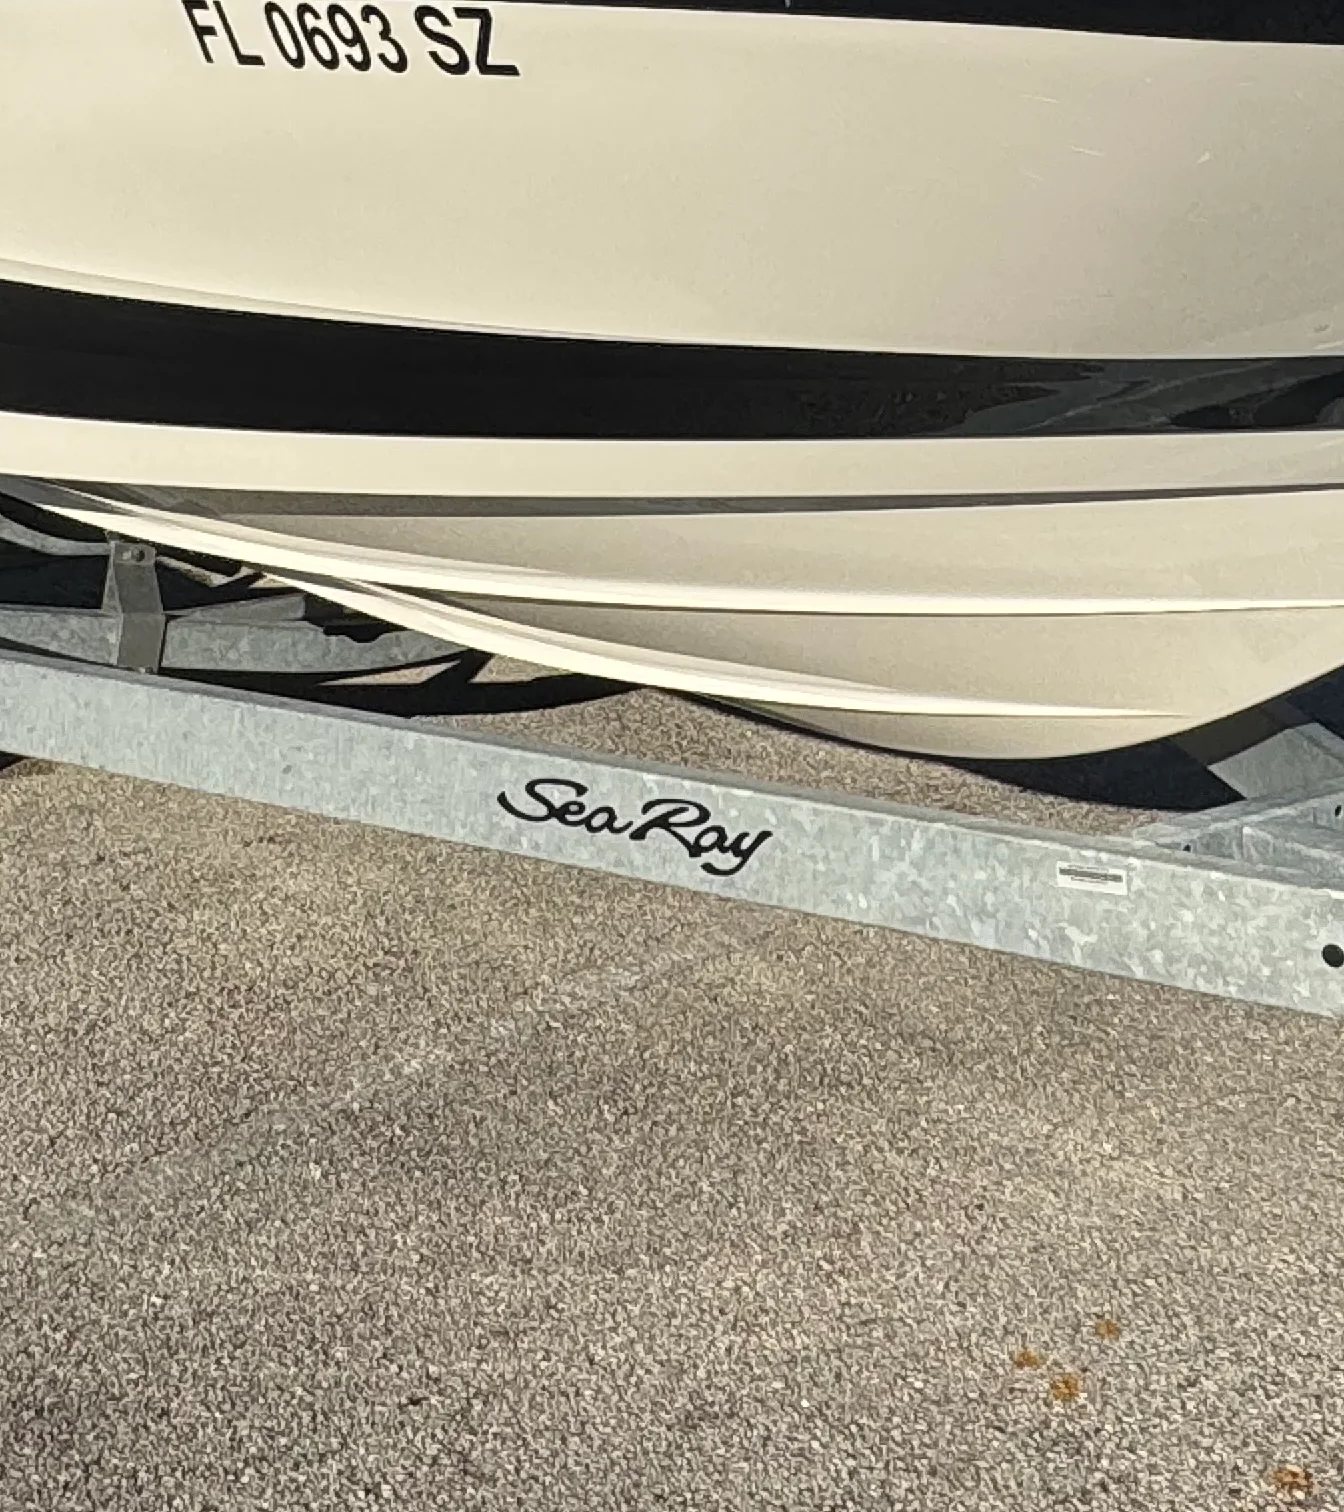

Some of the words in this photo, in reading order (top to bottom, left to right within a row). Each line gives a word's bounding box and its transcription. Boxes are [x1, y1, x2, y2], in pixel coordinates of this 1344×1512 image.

[264, 0, 409, 74] 0693
[413, 4, 521, 77] SZ
[496, 777, 634, 835] Sea
[628, 798, 774, 877] Ray
